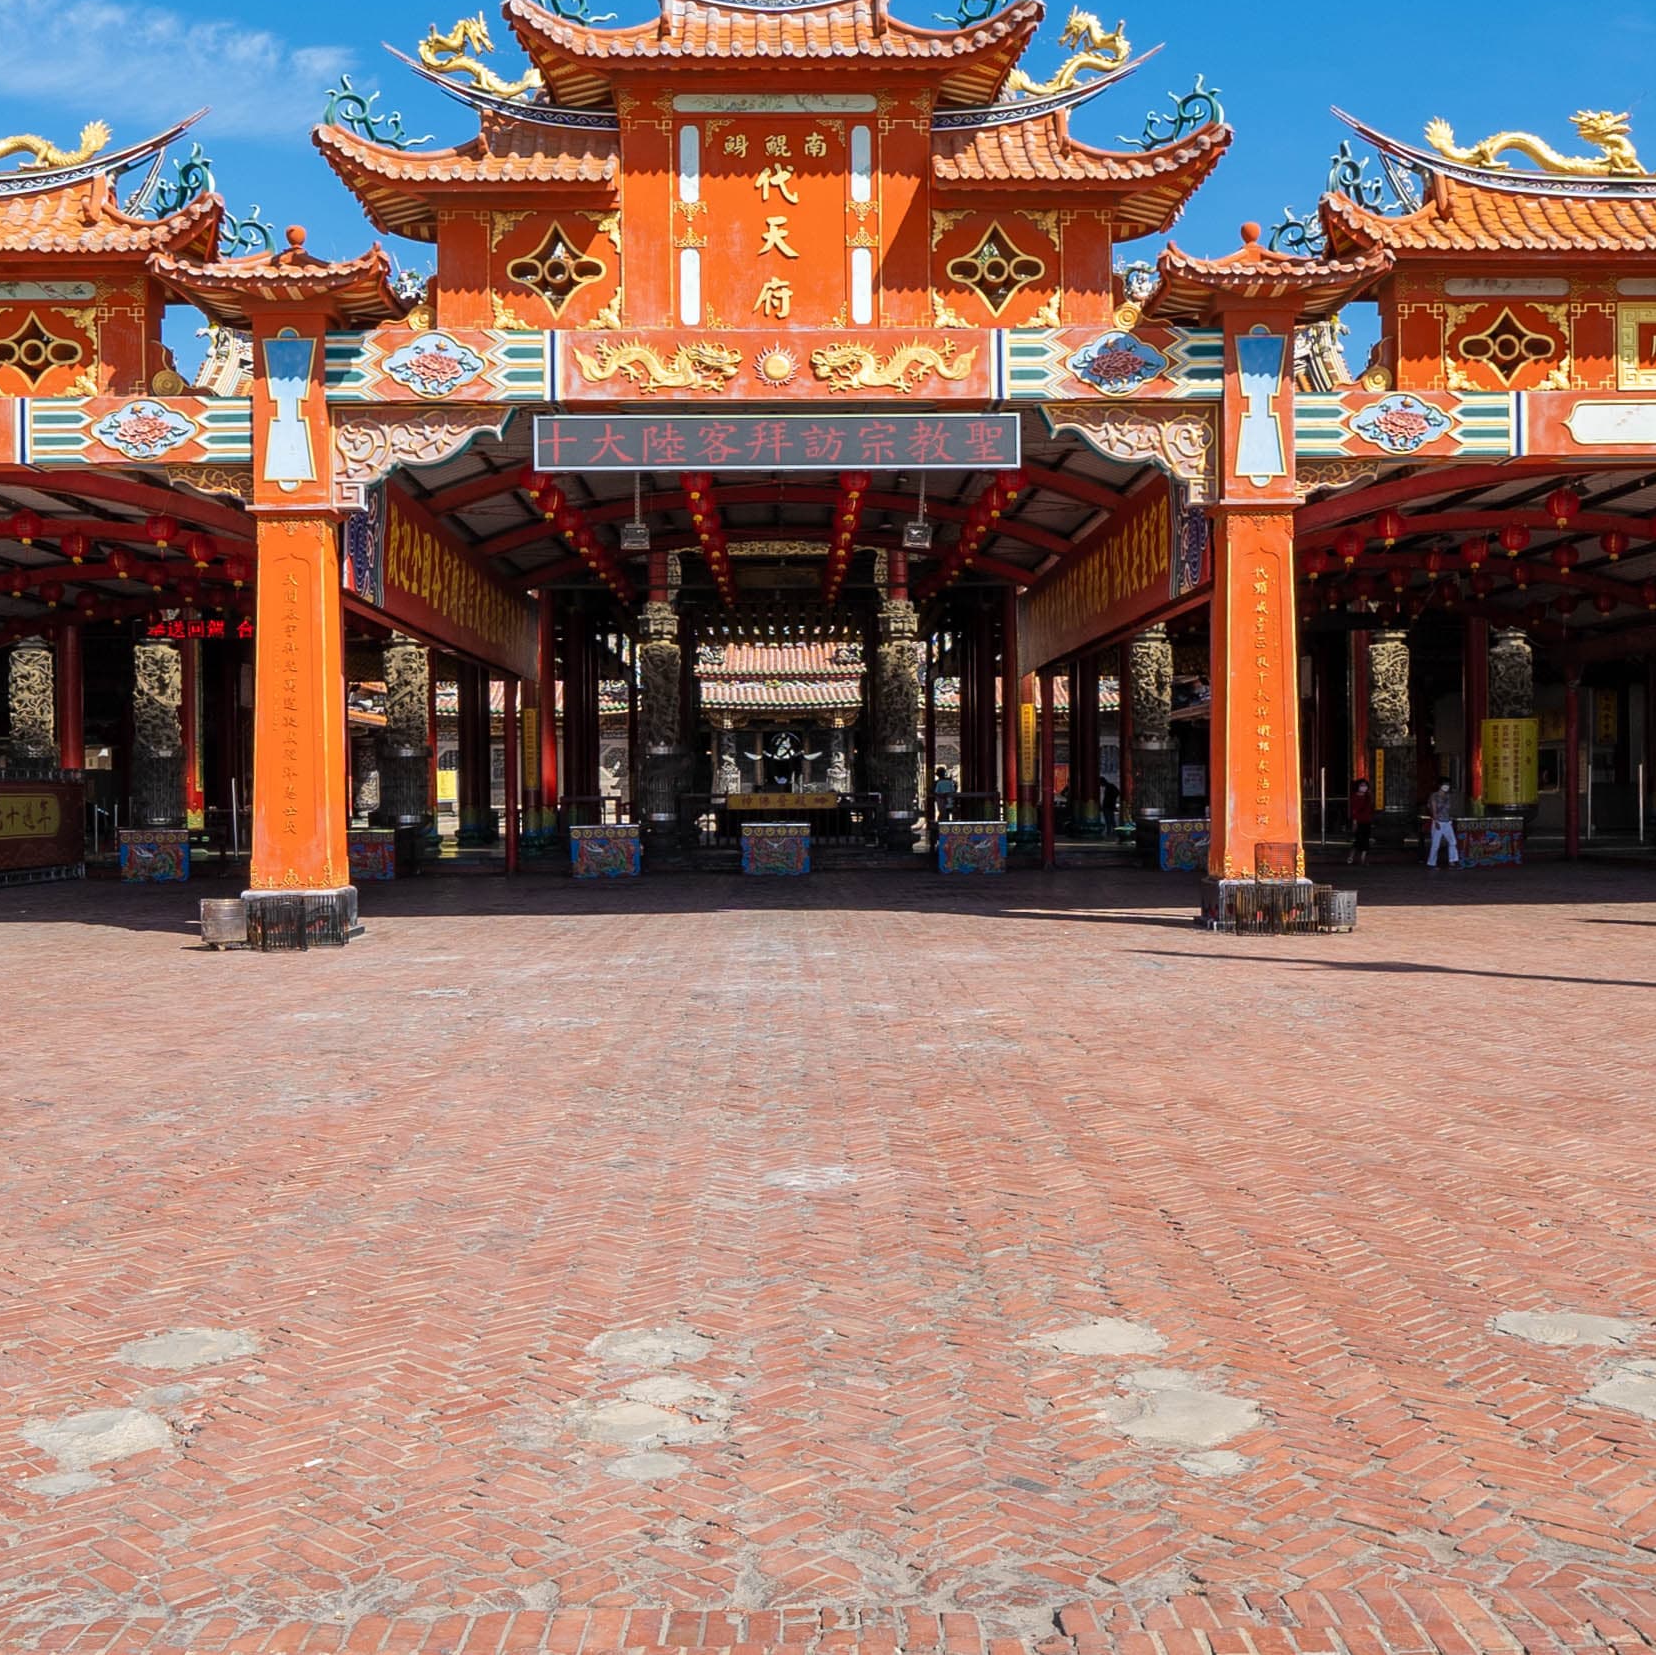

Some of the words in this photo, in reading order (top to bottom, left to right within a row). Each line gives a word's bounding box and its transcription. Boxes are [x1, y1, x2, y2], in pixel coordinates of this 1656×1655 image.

[753, 163, 799, 320] 代天府
[539, 421, 1004, 465] 十大陸客拜訪宗教聖
